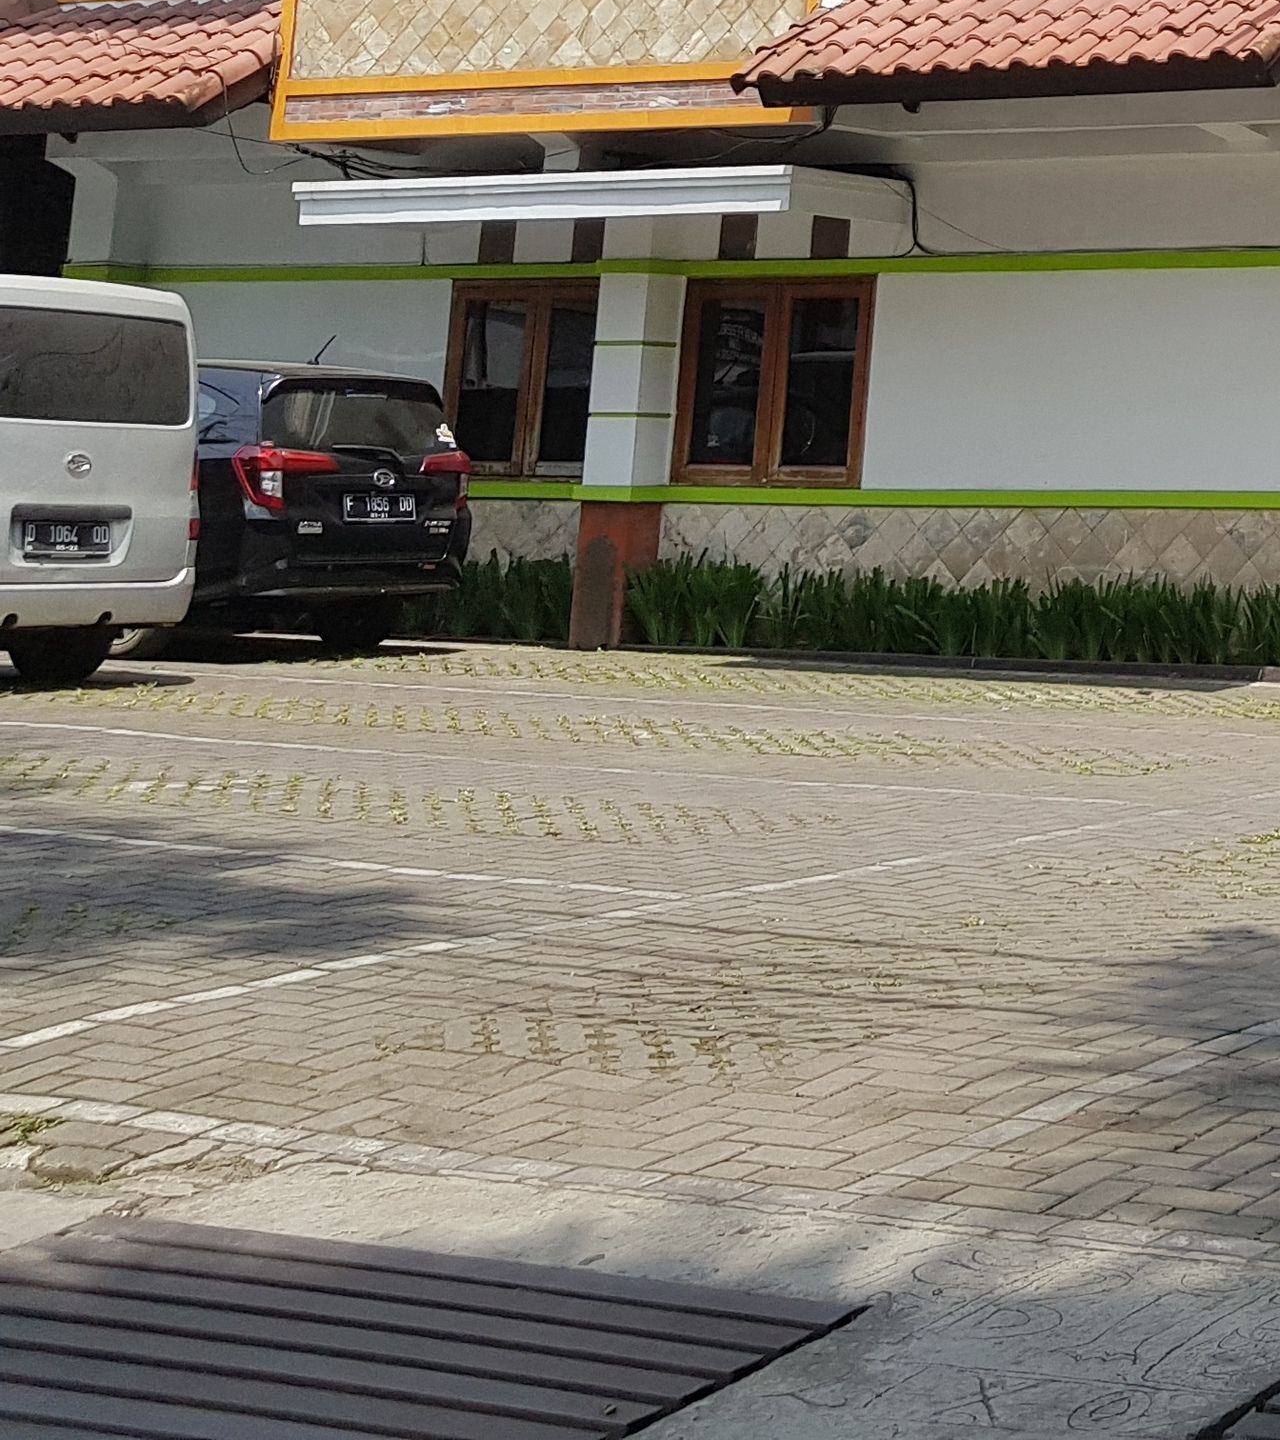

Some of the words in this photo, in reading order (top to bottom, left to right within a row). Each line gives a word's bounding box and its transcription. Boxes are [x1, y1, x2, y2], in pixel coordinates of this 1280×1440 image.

[346, 496, 354, 512] F
[365, 496, 390, 511] 1856
[28, 524, 36, 542] D
[49, 525, 79, 543] 1064
